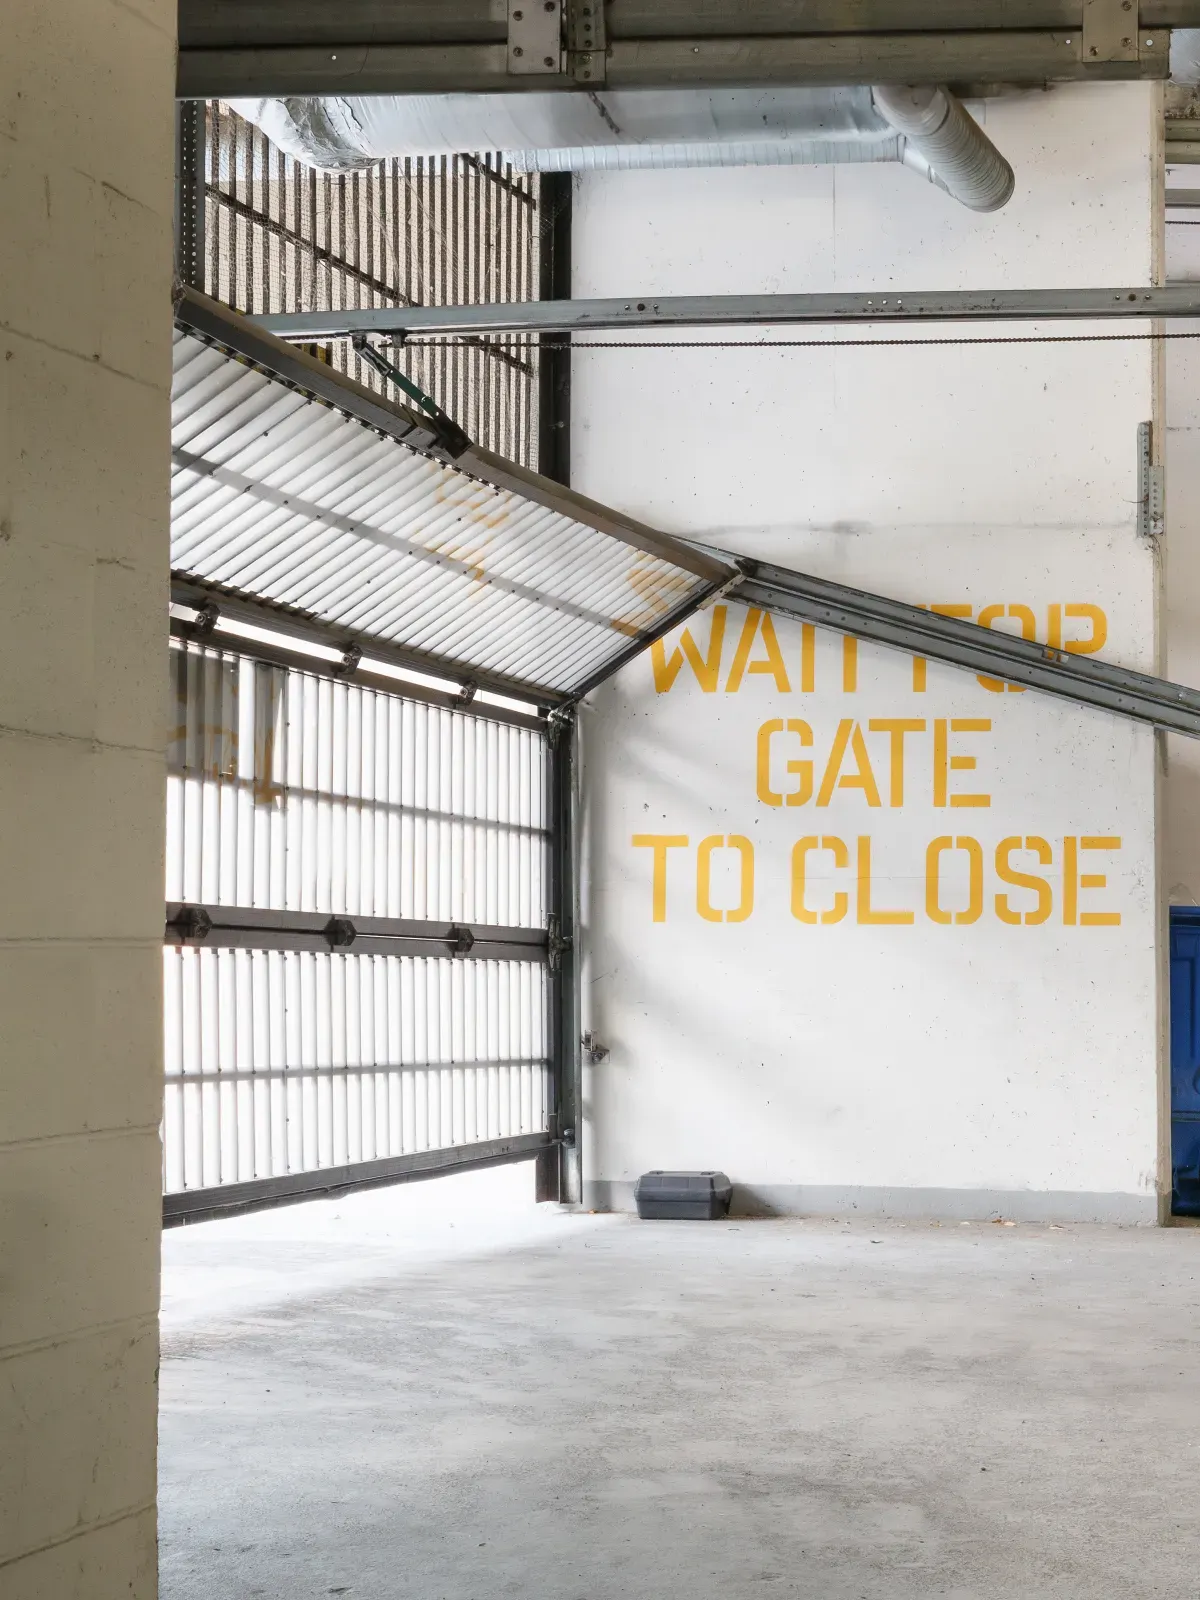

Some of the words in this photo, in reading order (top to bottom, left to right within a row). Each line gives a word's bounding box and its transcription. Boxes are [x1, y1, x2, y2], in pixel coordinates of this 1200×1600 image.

[757, 719, 991, 807] GATE
[633, 835, 753, 921] TO
[792, 836, 1120, 925] CLOSE
